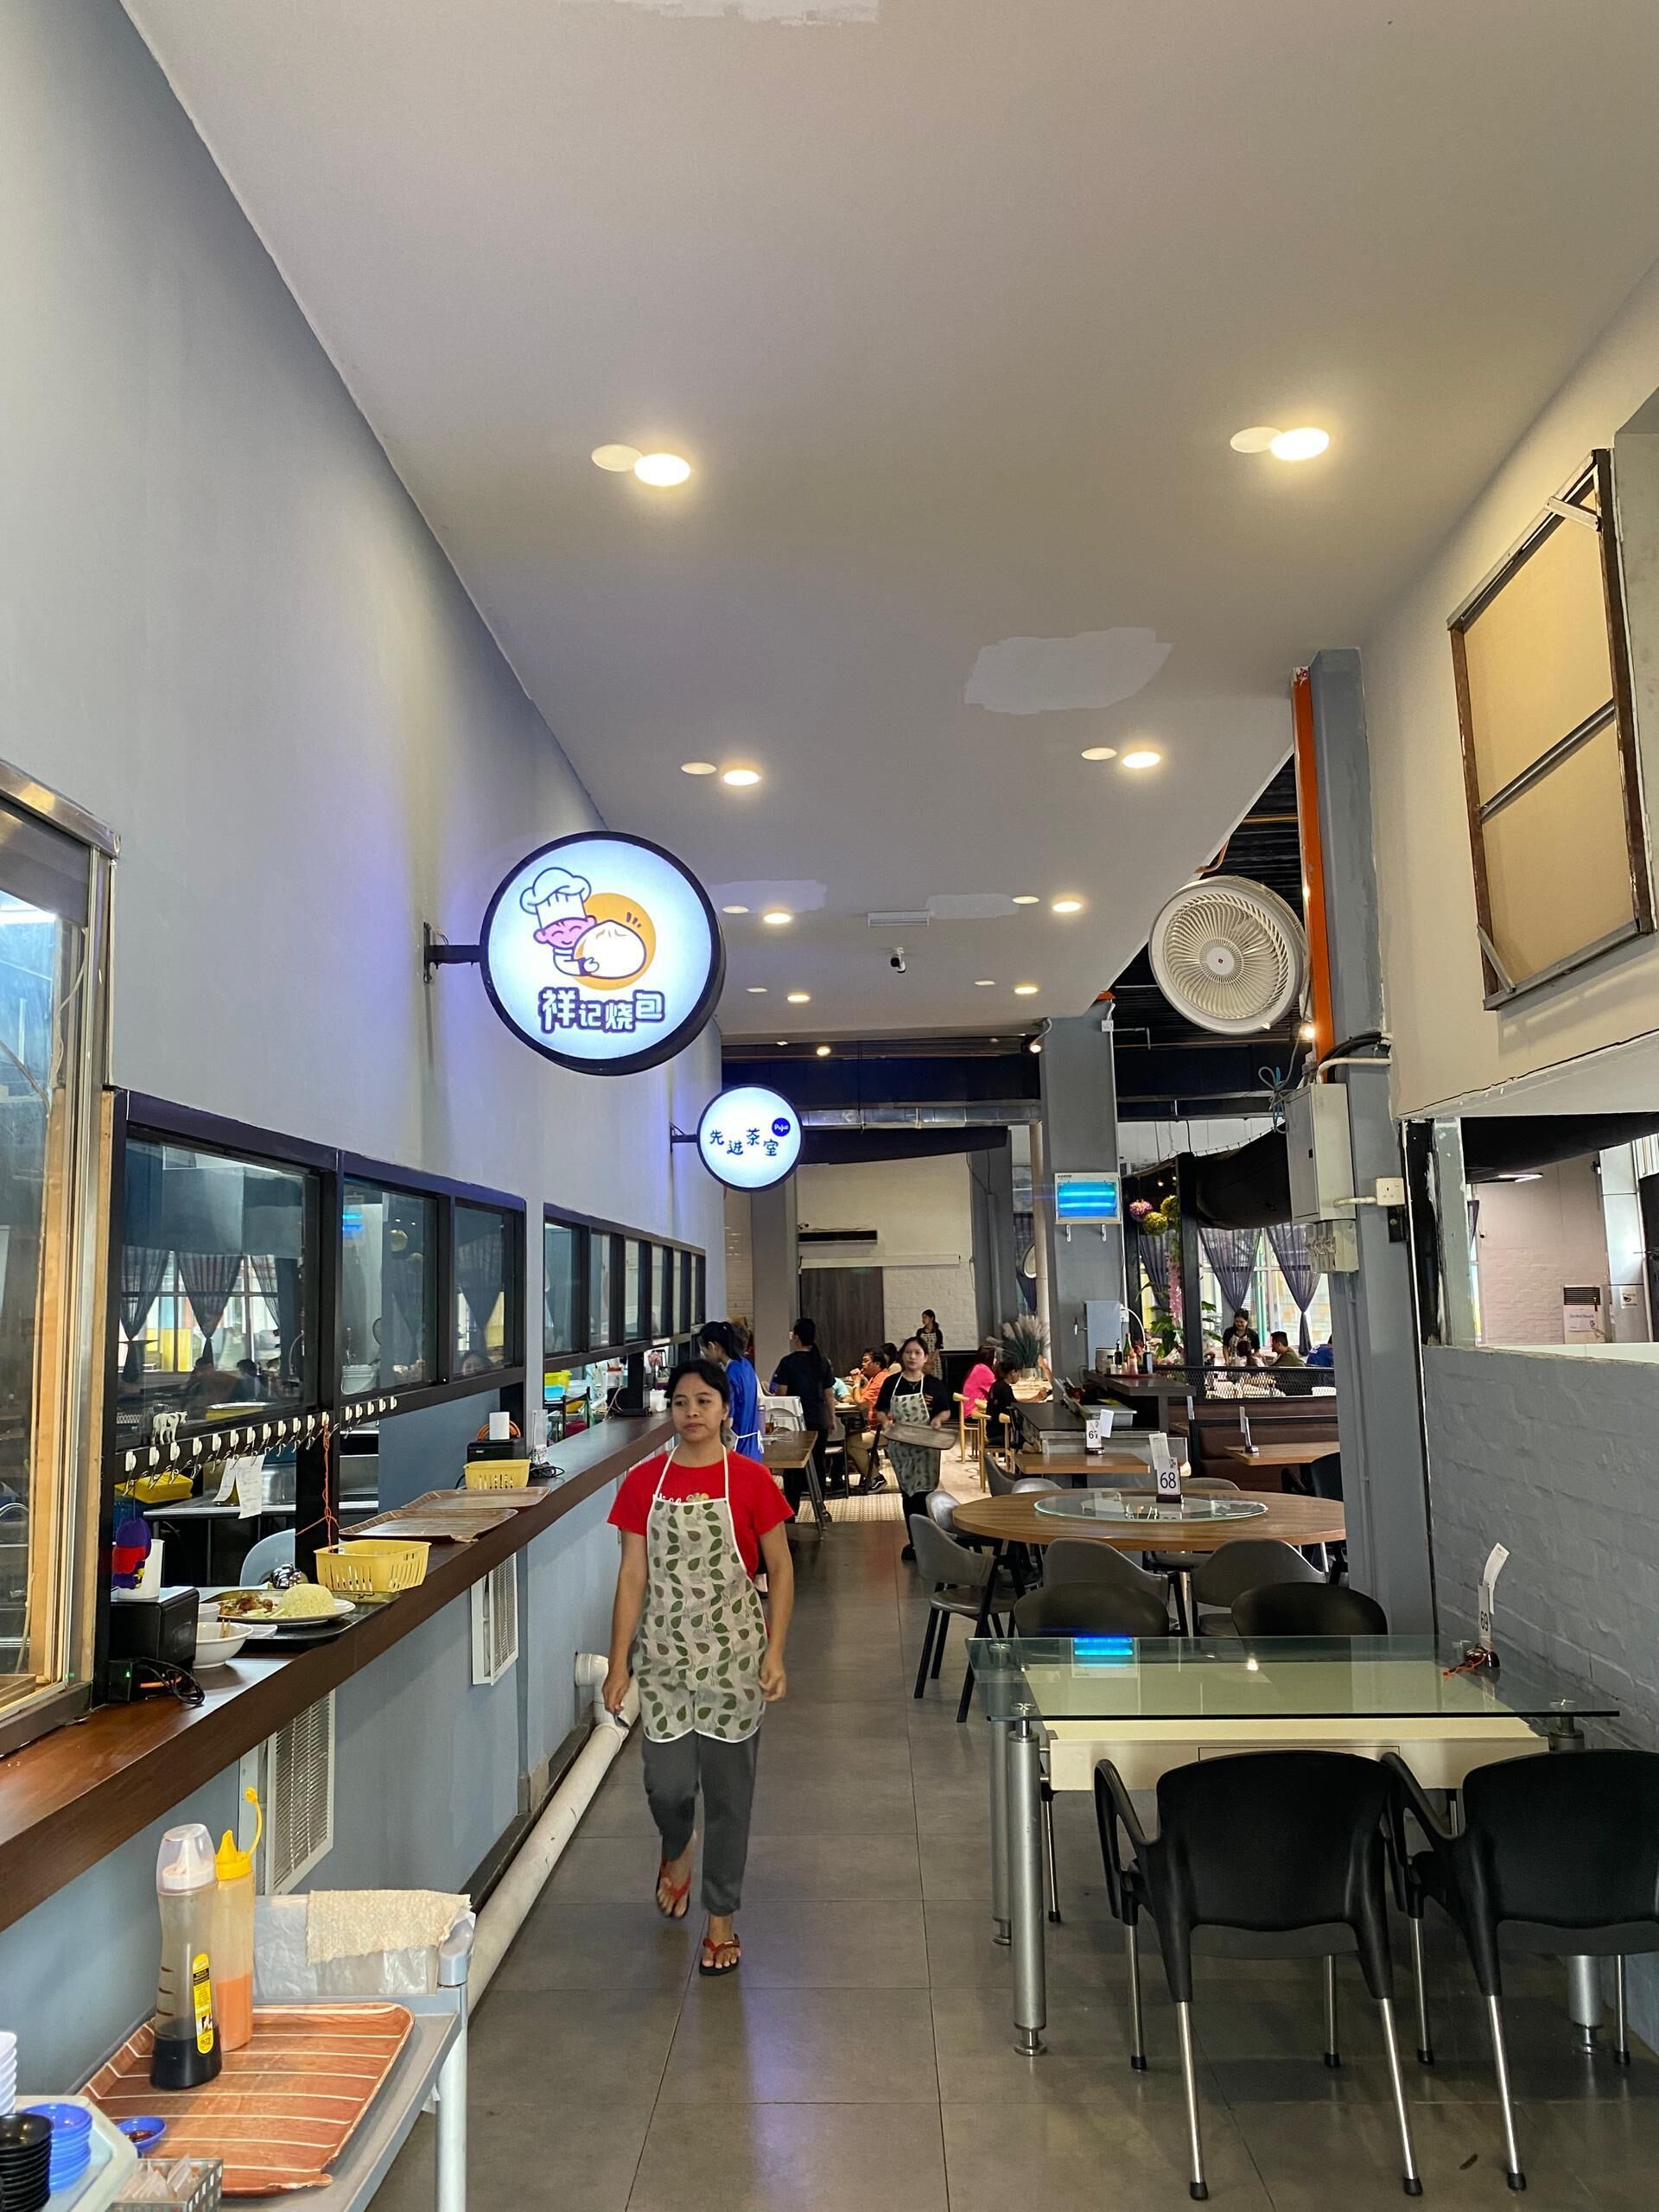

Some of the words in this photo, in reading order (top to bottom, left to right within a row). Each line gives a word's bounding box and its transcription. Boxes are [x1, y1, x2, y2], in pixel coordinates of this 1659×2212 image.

[539, 988, 664, 1033] 祥记烧包
[709, 1128, 779, 1157] 先进茶室
[1160, 1471, 1177, 1489] 68
[1480, 1610, 1489, 1632] 69
